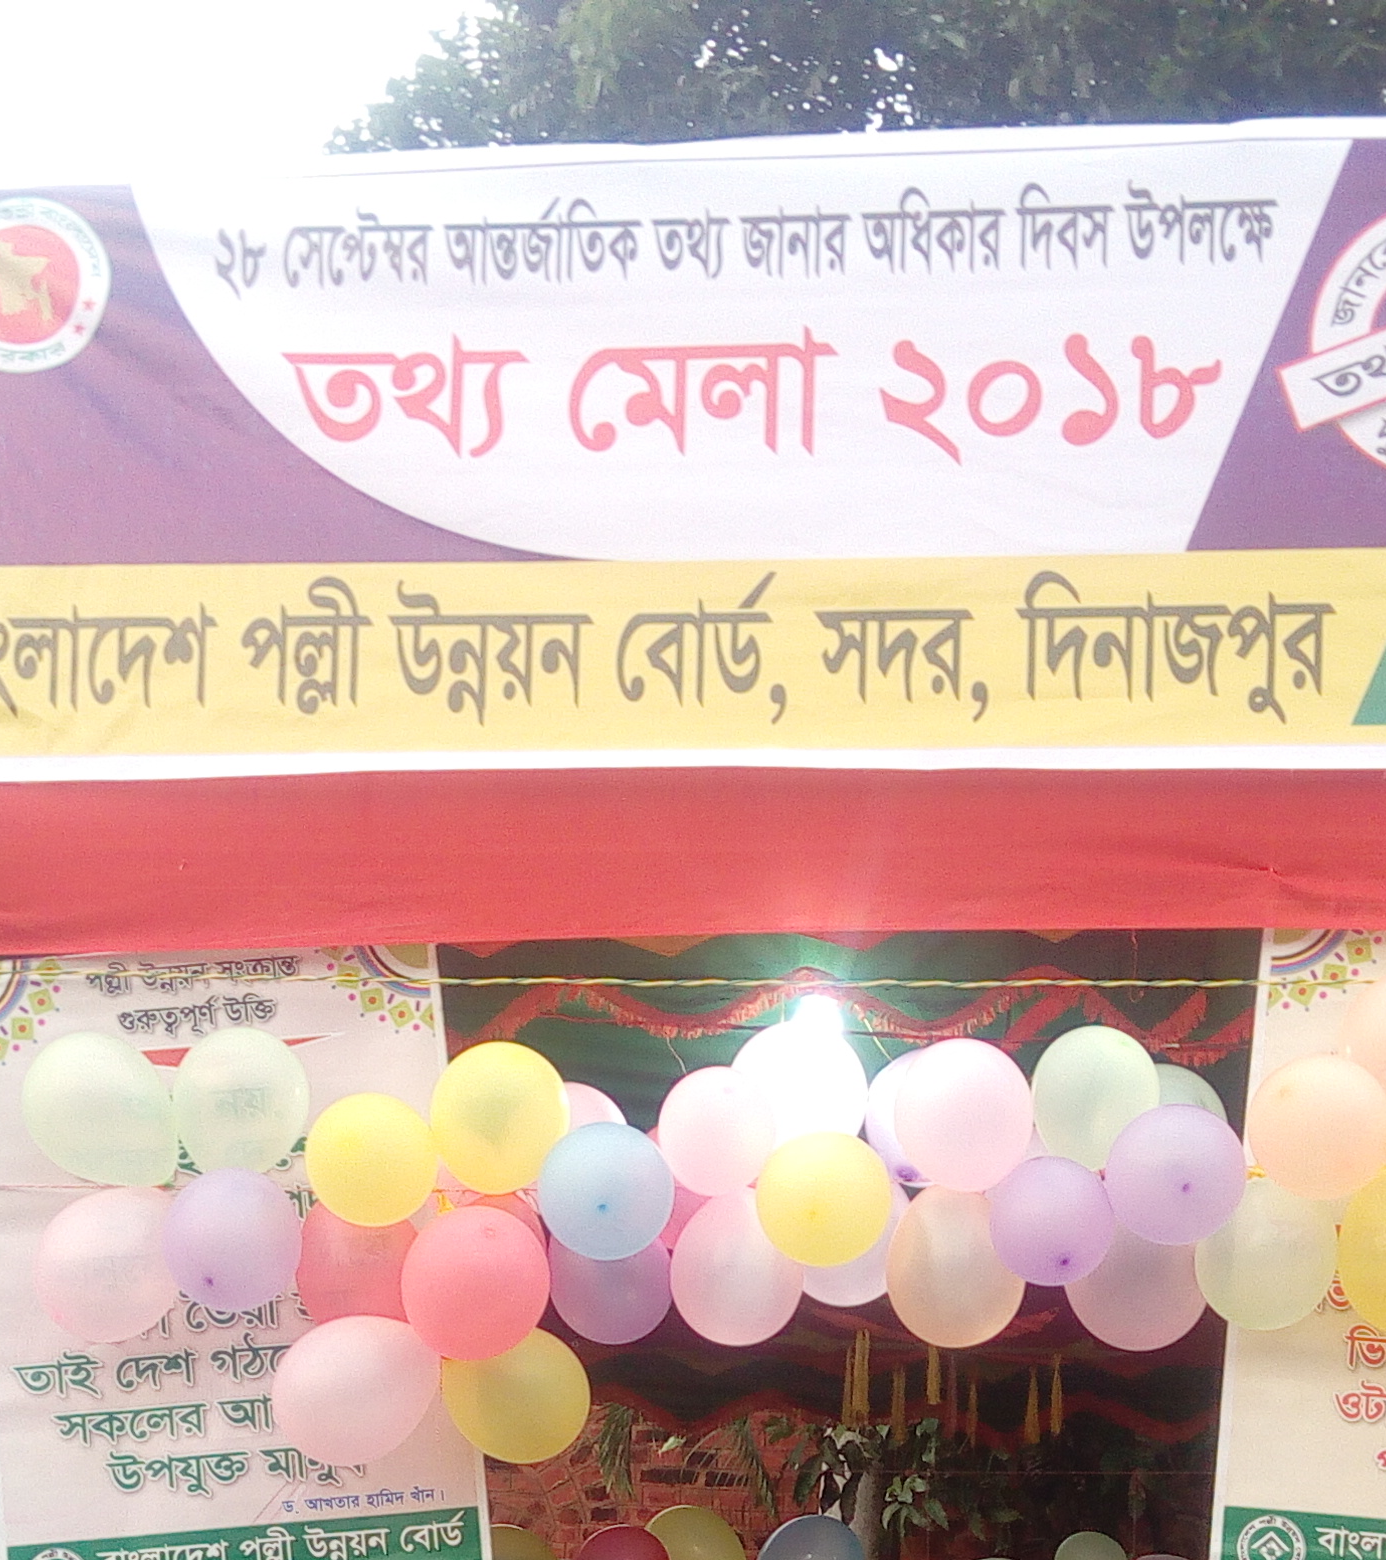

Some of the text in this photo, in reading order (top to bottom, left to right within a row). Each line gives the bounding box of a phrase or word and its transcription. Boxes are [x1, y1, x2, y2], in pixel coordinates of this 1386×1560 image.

[215, 178, 1277, 299] ২৮ সেপ্টেম্বর আন্তর্জাতিক তথ্য জানার অধিকার দিবস উপলক্ষে
[281, 325, 1222, 467] তথ্য মেলা ২০১৮
[241, 574, 374, 716] পল্লী
[388, 579, 594, 727] উন্নয়ন
[615, 571, 785, 724] বোর্ড,
[814, 601, 990, 723] সদর,
[1014, 570, 1338, 724] দিনাজপুর
[118, 993, 277, 1036] গুরুত্বপূর্ণ উক্তি
[13, 1348, 195, 1398] তাই দেশ
[53, 1401, 210, 1446] সকলের
[105, 1449, 251, 1496] উপযুক্ত
[367, 1492, 405, 1508] হামিদ
[400, 1512, 466, 1552] বোর্ড
